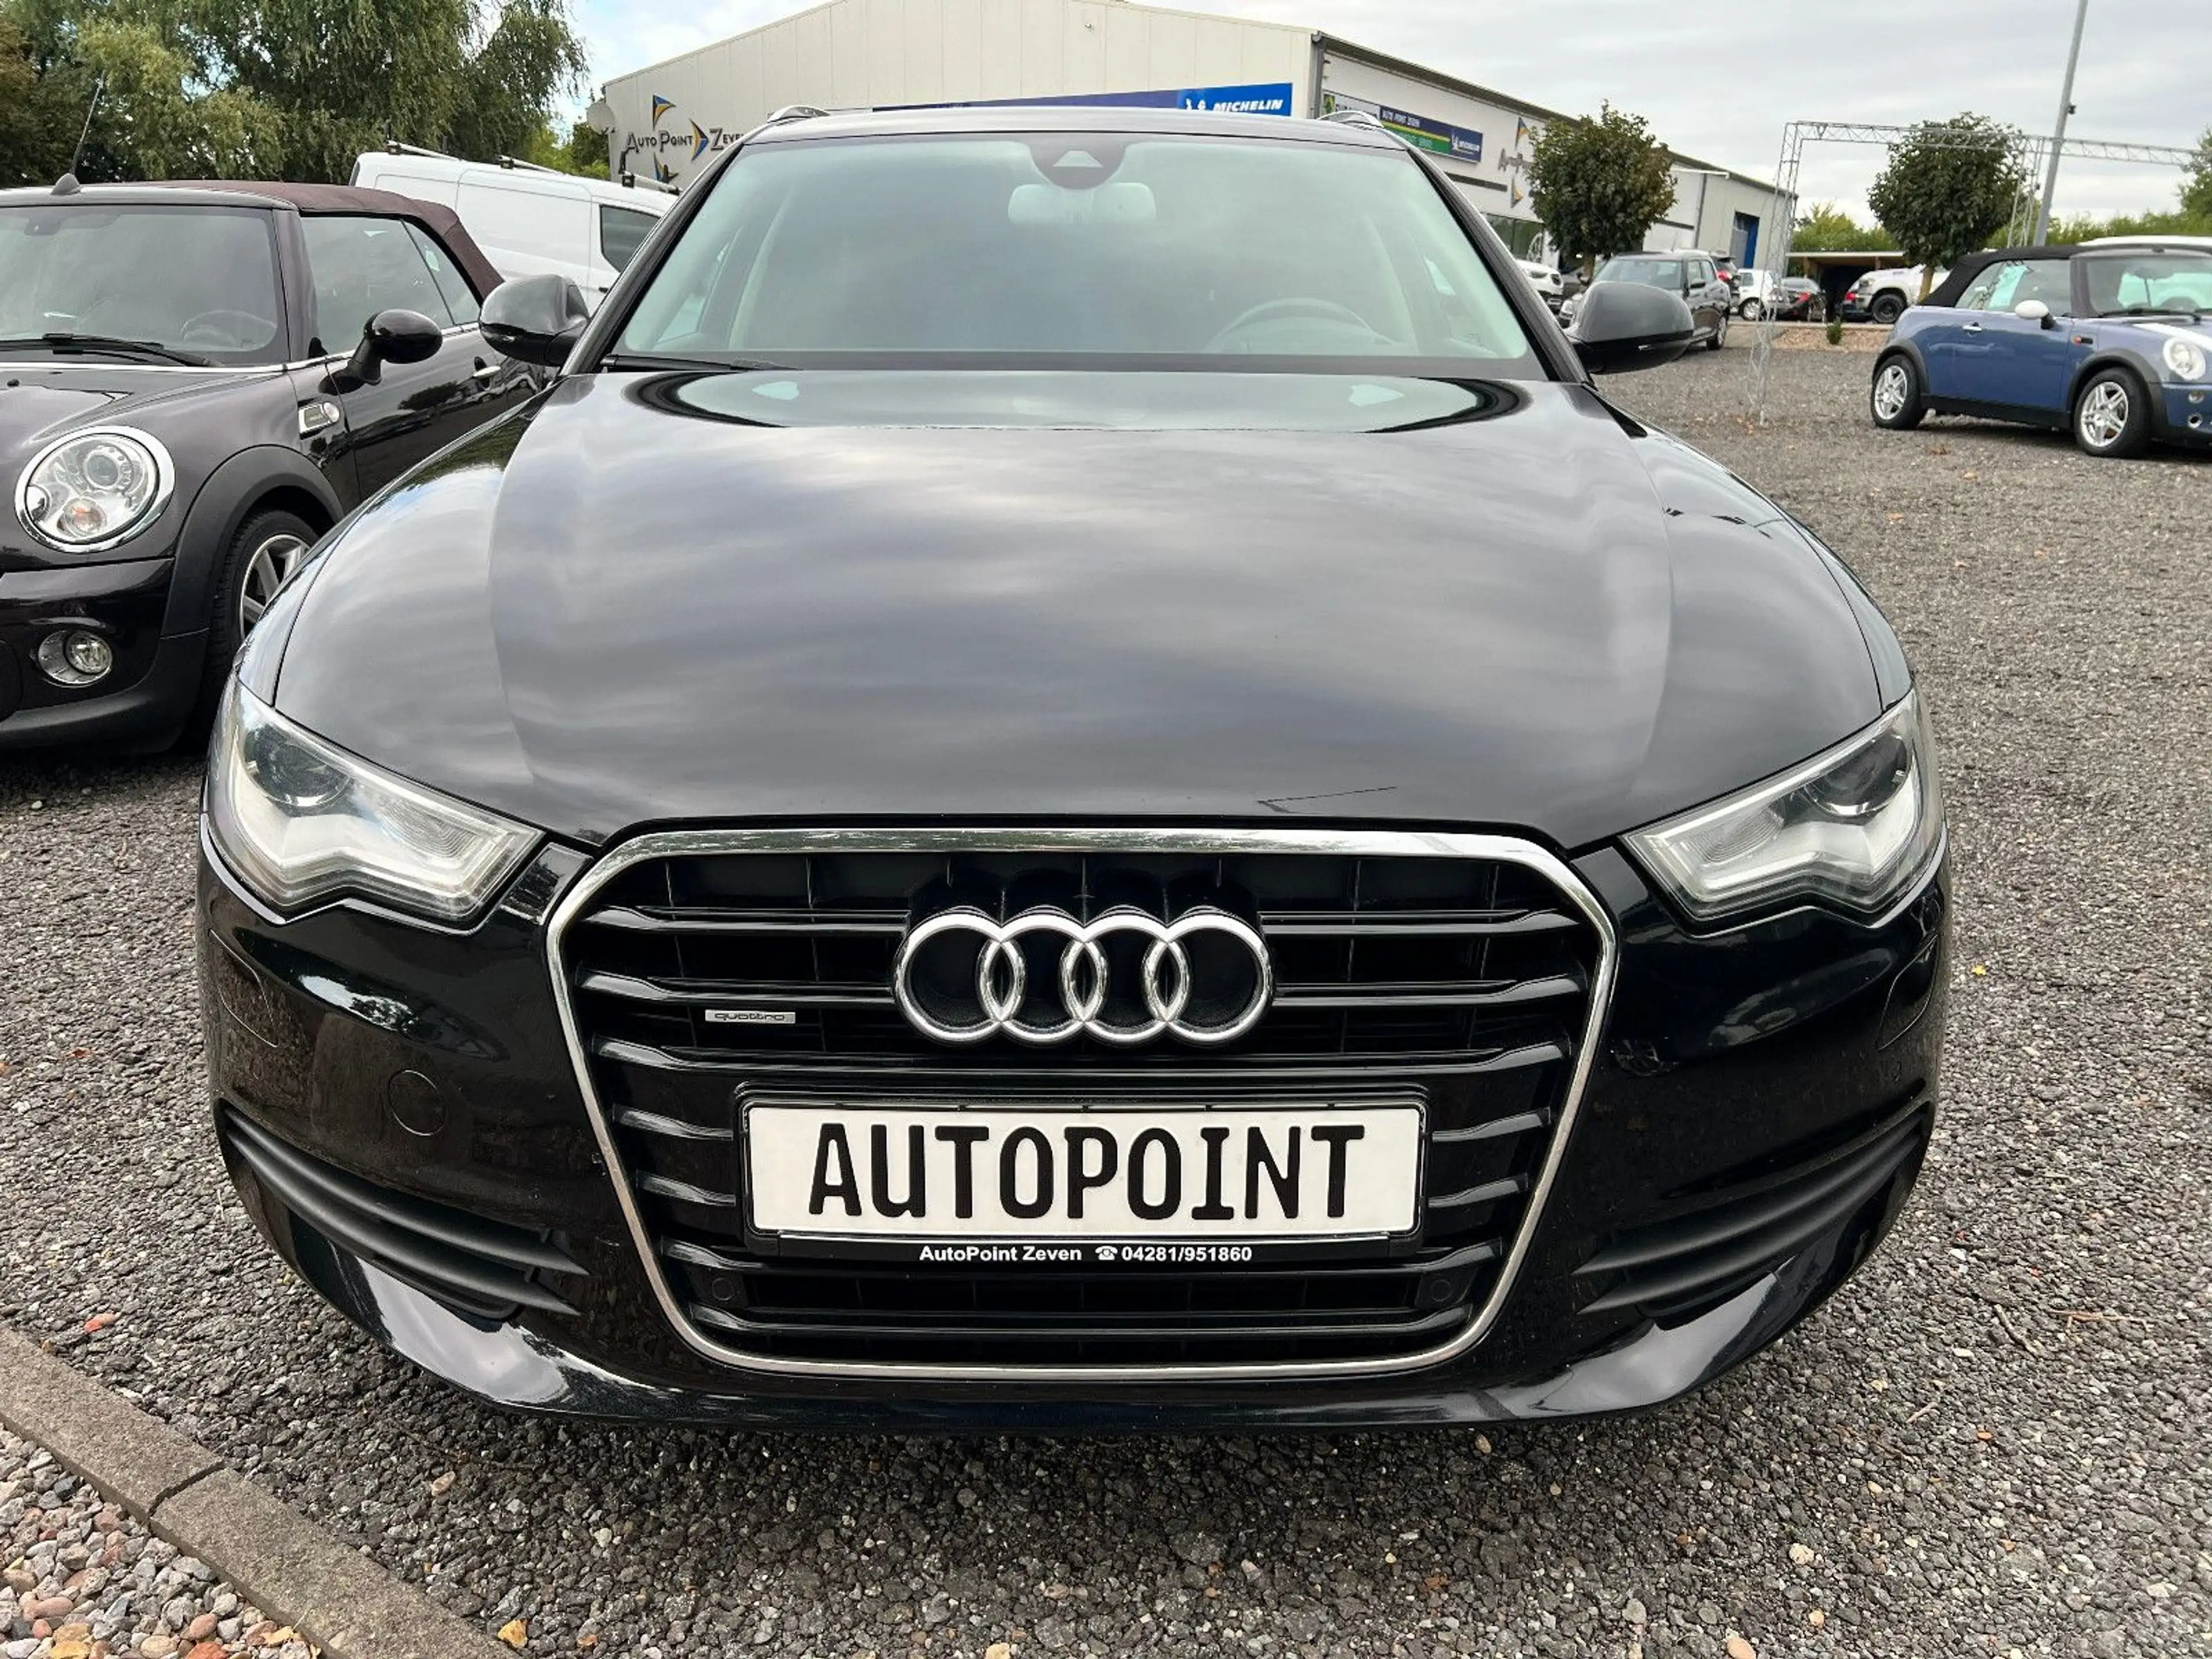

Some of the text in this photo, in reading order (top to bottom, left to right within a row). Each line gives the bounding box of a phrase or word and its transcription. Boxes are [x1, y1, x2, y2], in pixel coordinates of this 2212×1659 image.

[1213, 99, 1283, 112] MICHELIN
[709, 128, 745, 150] ZEVE
[714, 1013, 785, 1021] quattro
[808, 1123, 1365, 1221] AUTOPOINT
[919, 1246, 1252, 1262] AutoPoint Zeven 04281/951860
